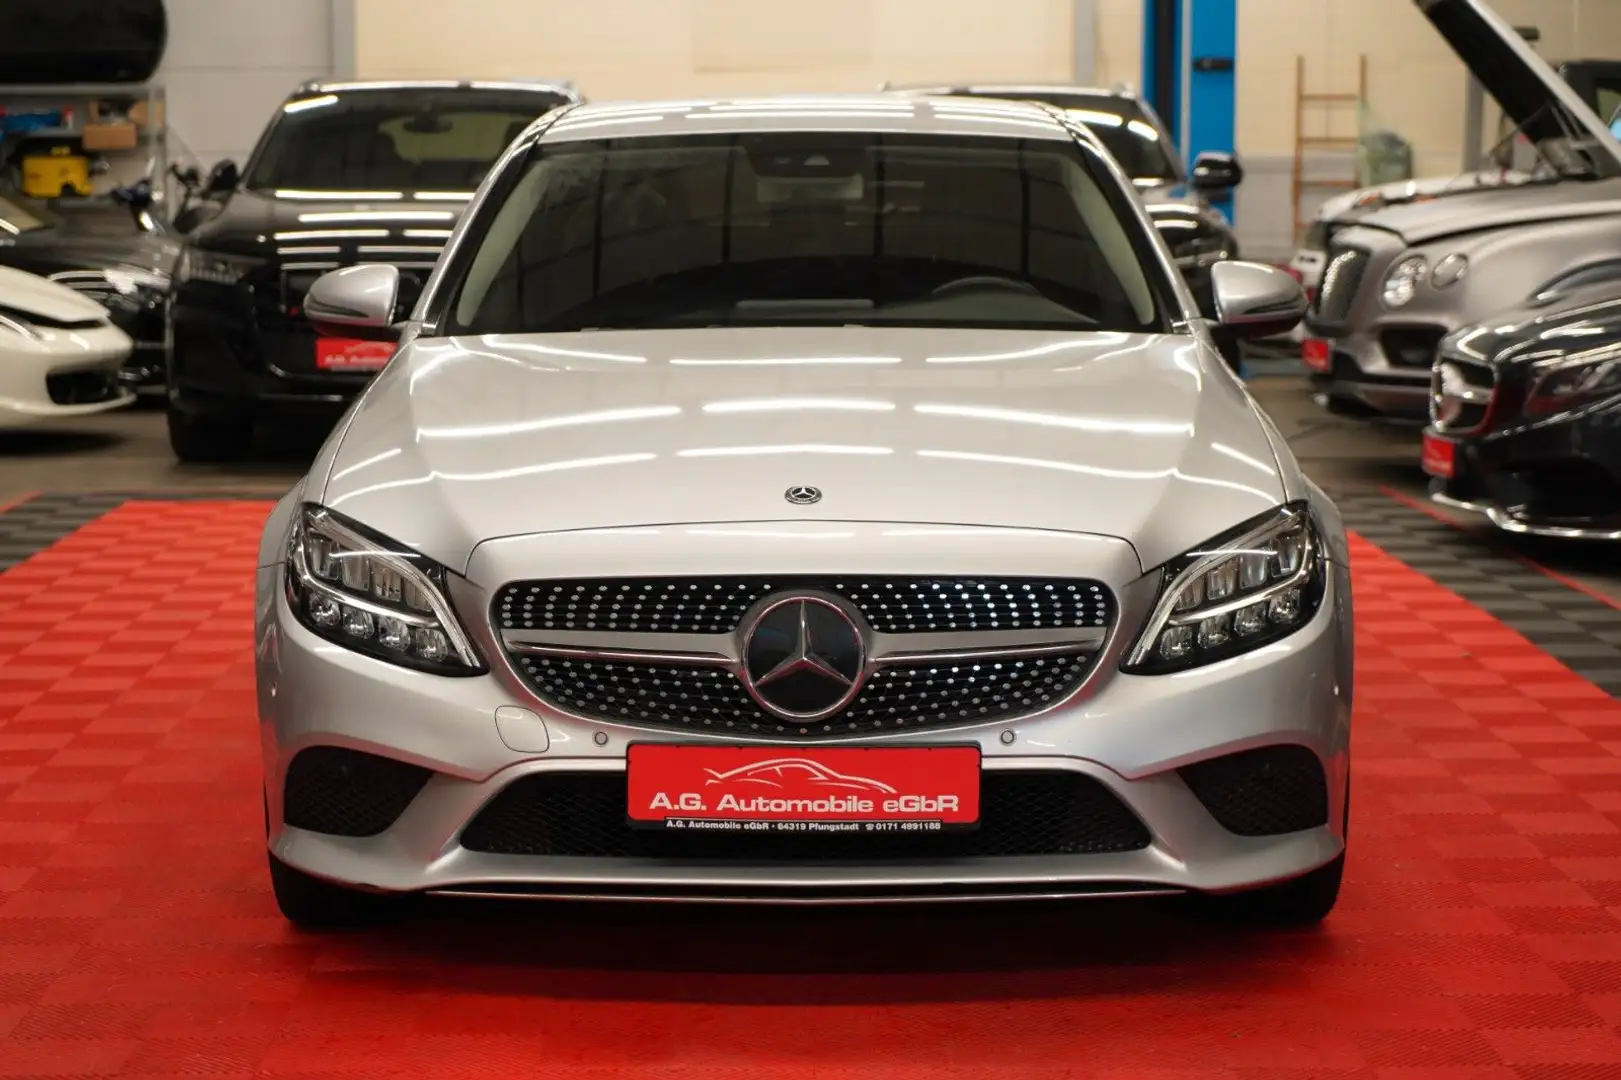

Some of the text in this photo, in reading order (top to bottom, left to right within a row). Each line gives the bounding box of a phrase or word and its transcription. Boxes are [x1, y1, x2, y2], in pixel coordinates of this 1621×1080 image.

[649, 792, 960, 813] A.G. Automobile eGbR
[666, 820, 685, 828] A.G.
[688, 820, 741, 830] Automobile
[743, 820, 770, 830] eGbR
[777, 820, 806, 831] 64319
[808, 822, 859, 832] Pfungstadt
[876, 822, 898, 831] 0171
